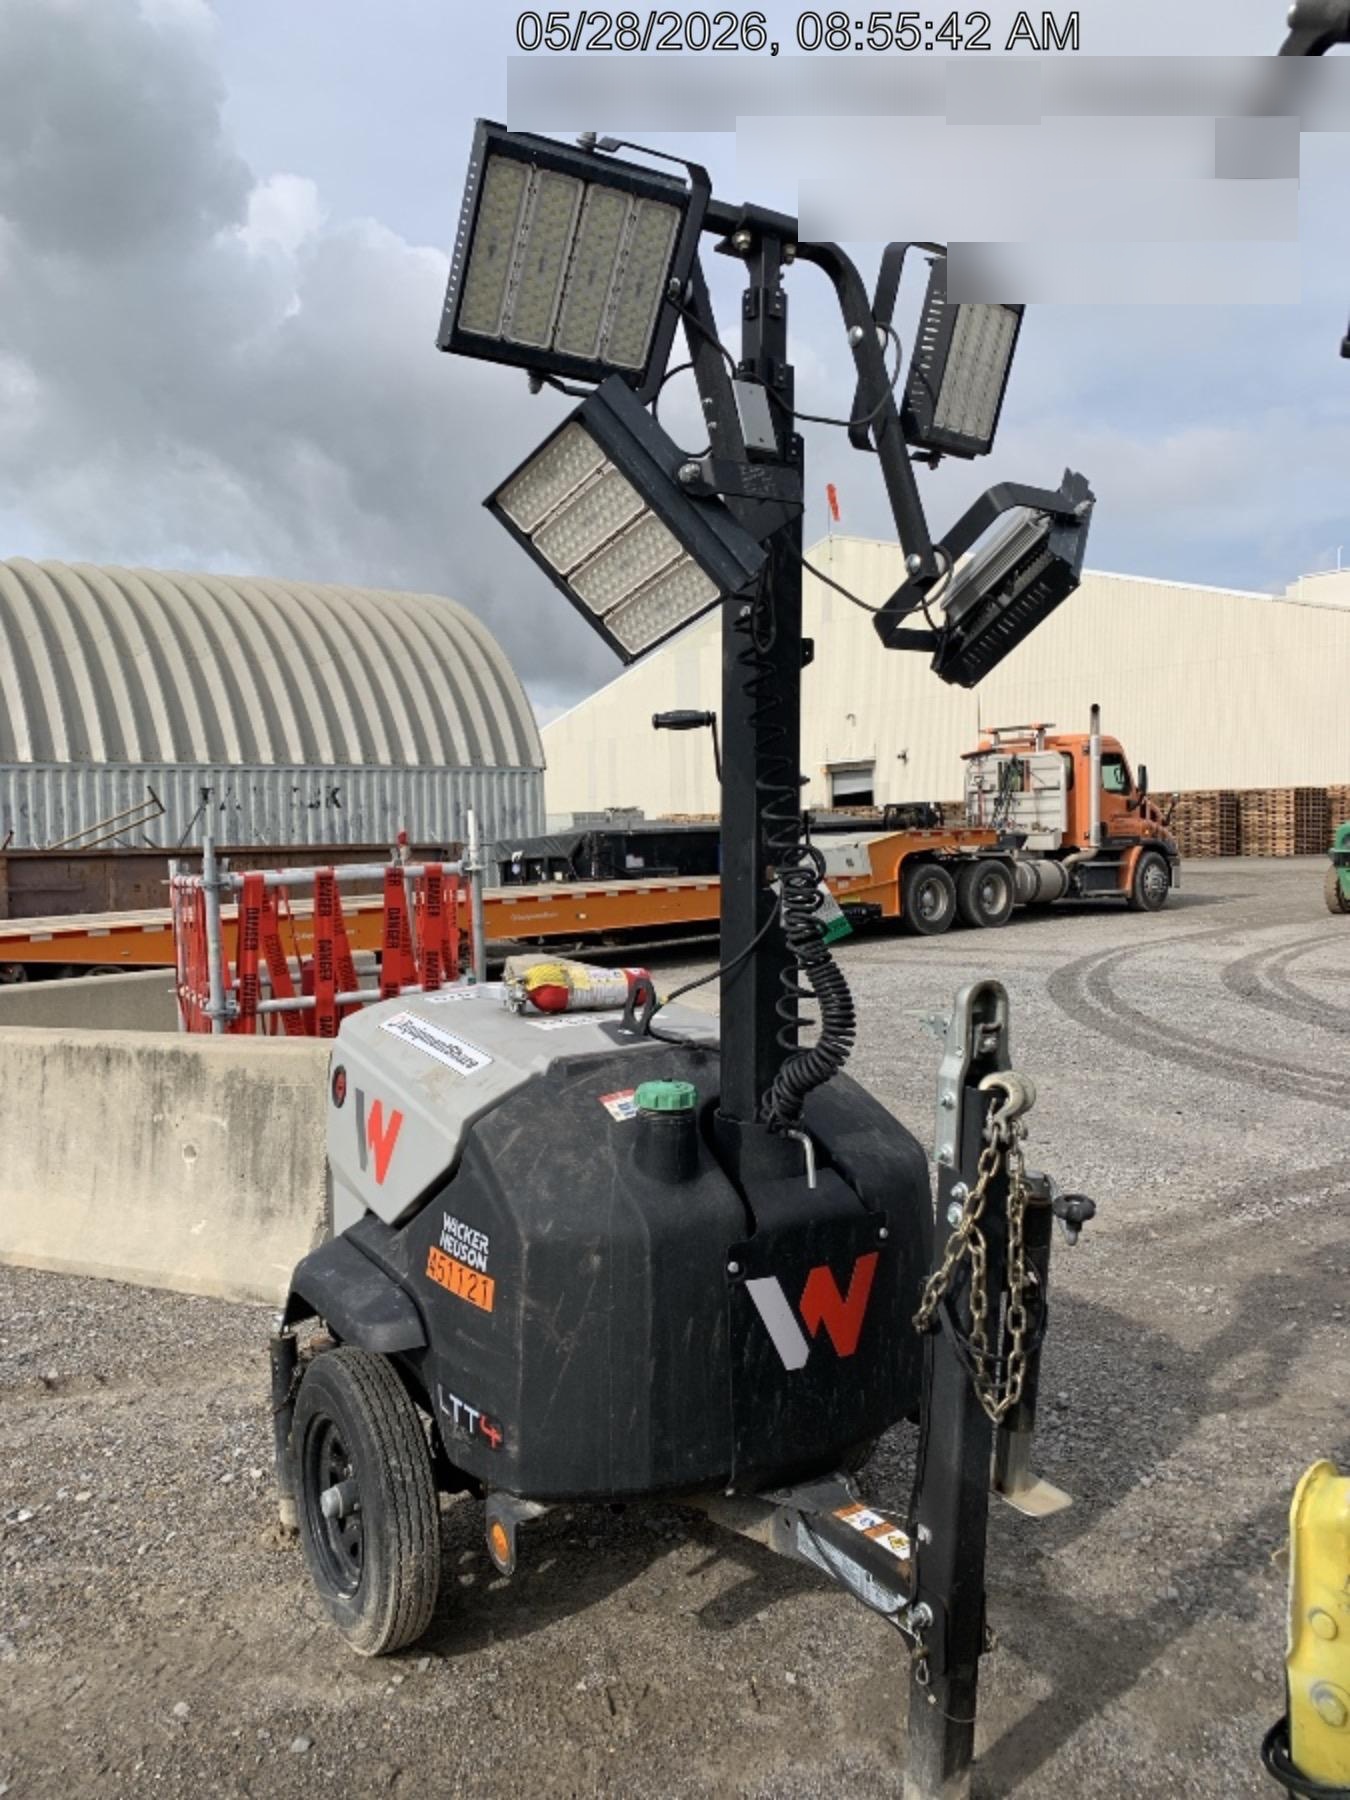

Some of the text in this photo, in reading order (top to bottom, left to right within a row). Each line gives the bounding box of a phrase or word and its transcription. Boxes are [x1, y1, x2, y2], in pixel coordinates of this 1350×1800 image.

[386, 907, 401, 949] DANGER
[318, 939, 333, 981] DANGER
[440, 1229, 487, 1272] NEUSON
[443, 1211, 489, 1255] WACKER
[428, 1250, 490, 1308] 451121
[437, 1383, 503, 1449] LTT4
